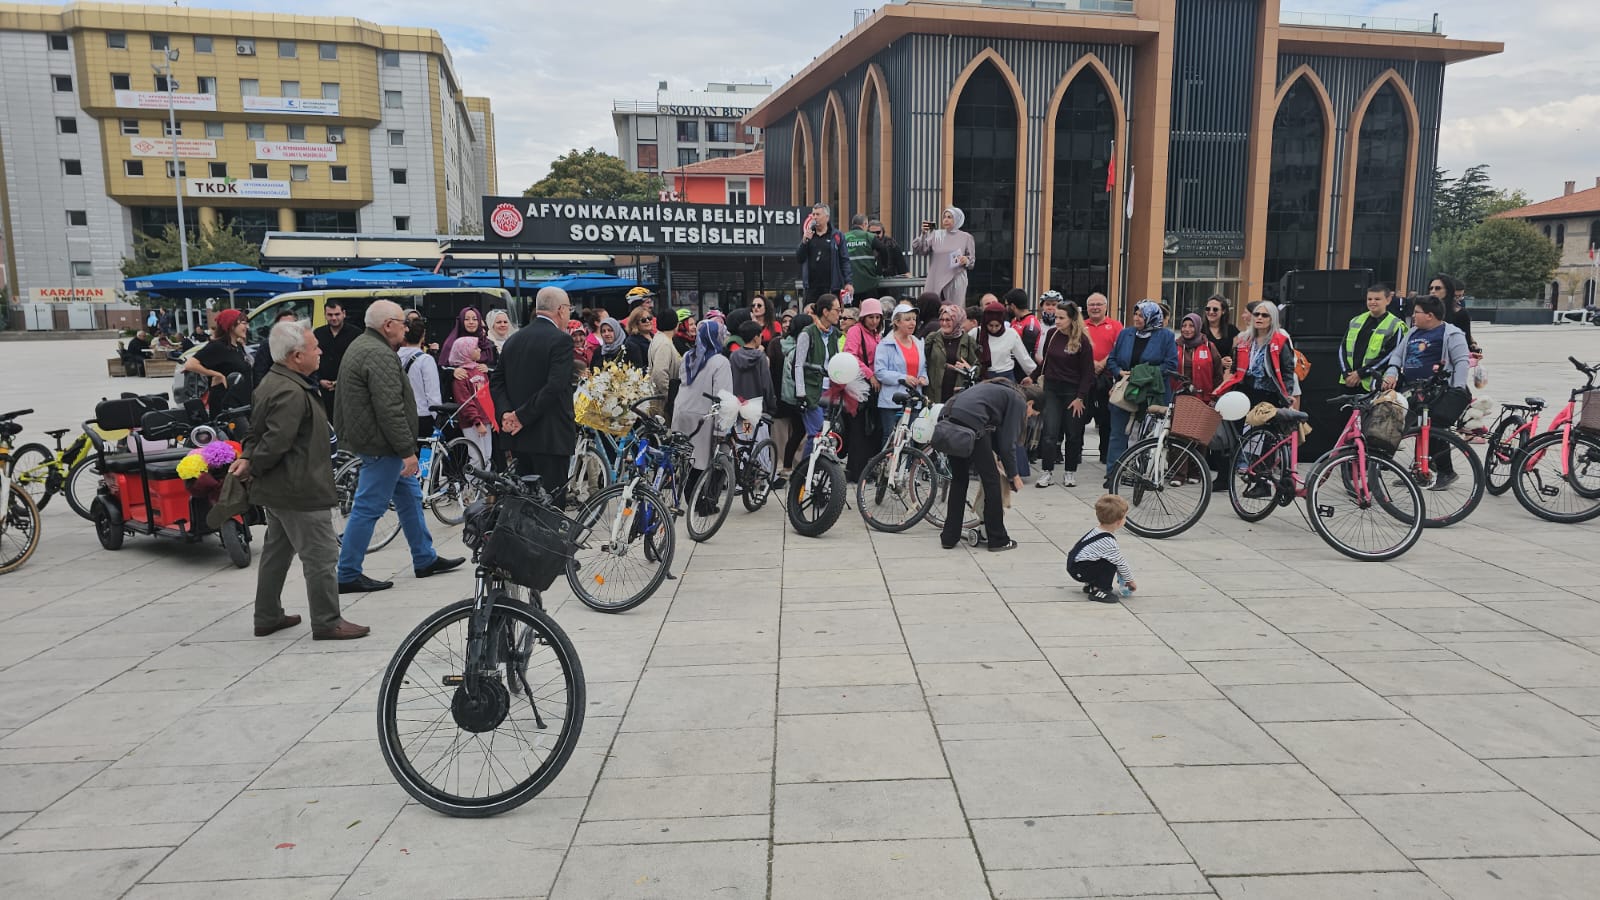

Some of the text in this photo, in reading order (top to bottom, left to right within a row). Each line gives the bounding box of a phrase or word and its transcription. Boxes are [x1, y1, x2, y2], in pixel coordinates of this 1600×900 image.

[670, 105, 717, 117] SOYDAN
[723, 107, 752, 118] BUSI
[195, 183, 238, 193] TKDK
[659, 191, 681, 202] T.C.
[526, 203, 800, 225] AFYONKARAHİSAR BELEDİYESİ
[570, 223, 765, 245] SOSYAL TESİSLERİ
[40, 288, 104, 296] KARAMAN
